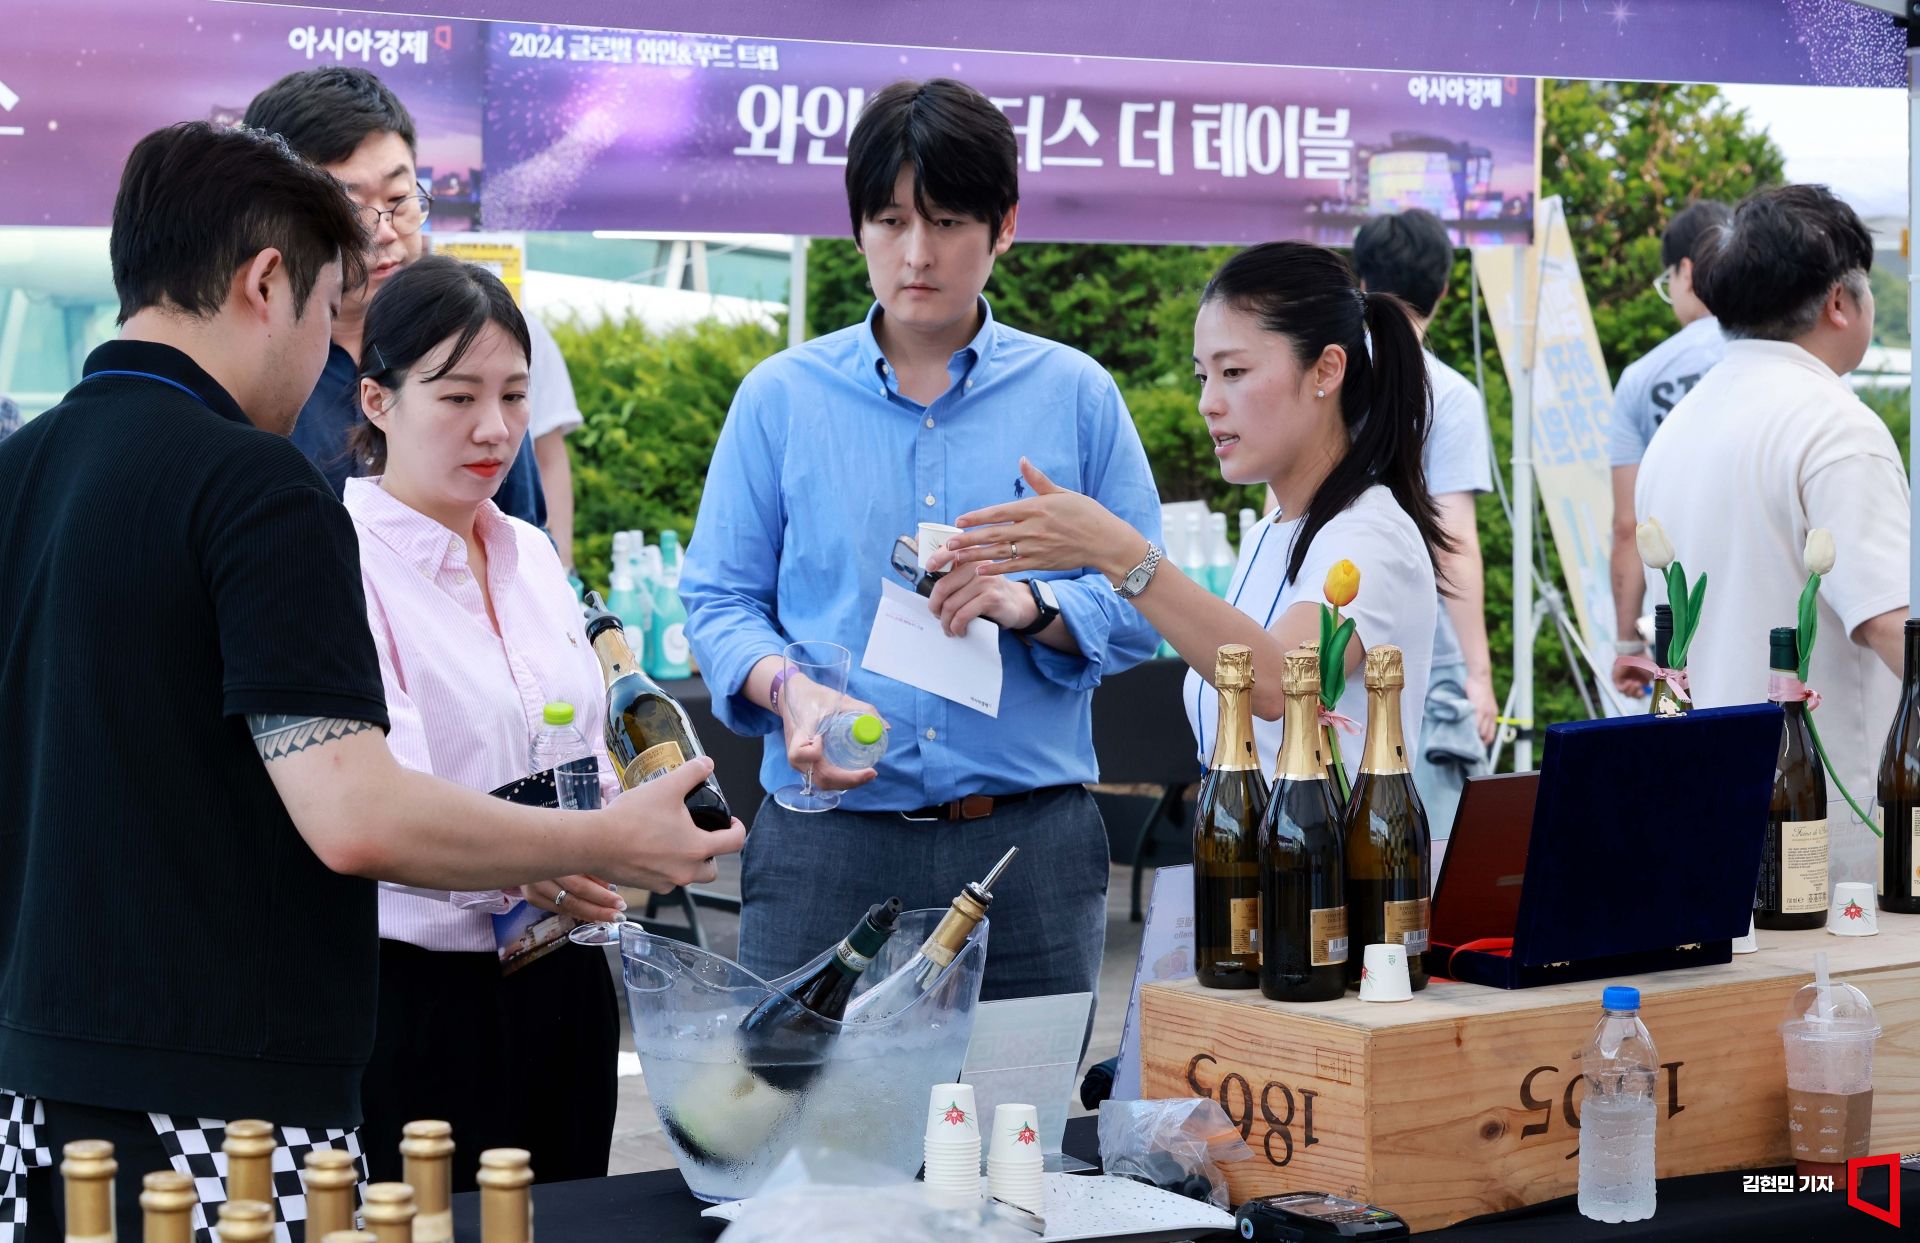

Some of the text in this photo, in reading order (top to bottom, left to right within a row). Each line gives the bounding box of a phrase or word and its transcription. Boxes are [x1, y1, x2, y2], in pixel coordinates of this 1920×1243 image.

[288, 25, 429, 67] 아시아경제
[508, 32, 565, 59] 2024
[568, 34, 633, 63] 글로벌
[738, 44, 779, 70] 트립
[1408, 75, 1503, 111] 아시아경제
[1118, 100, 1176, 176] 더
[1191, 102, 1354, 179] 테이블
[1187, 1053, 1319, 1167] 1865
